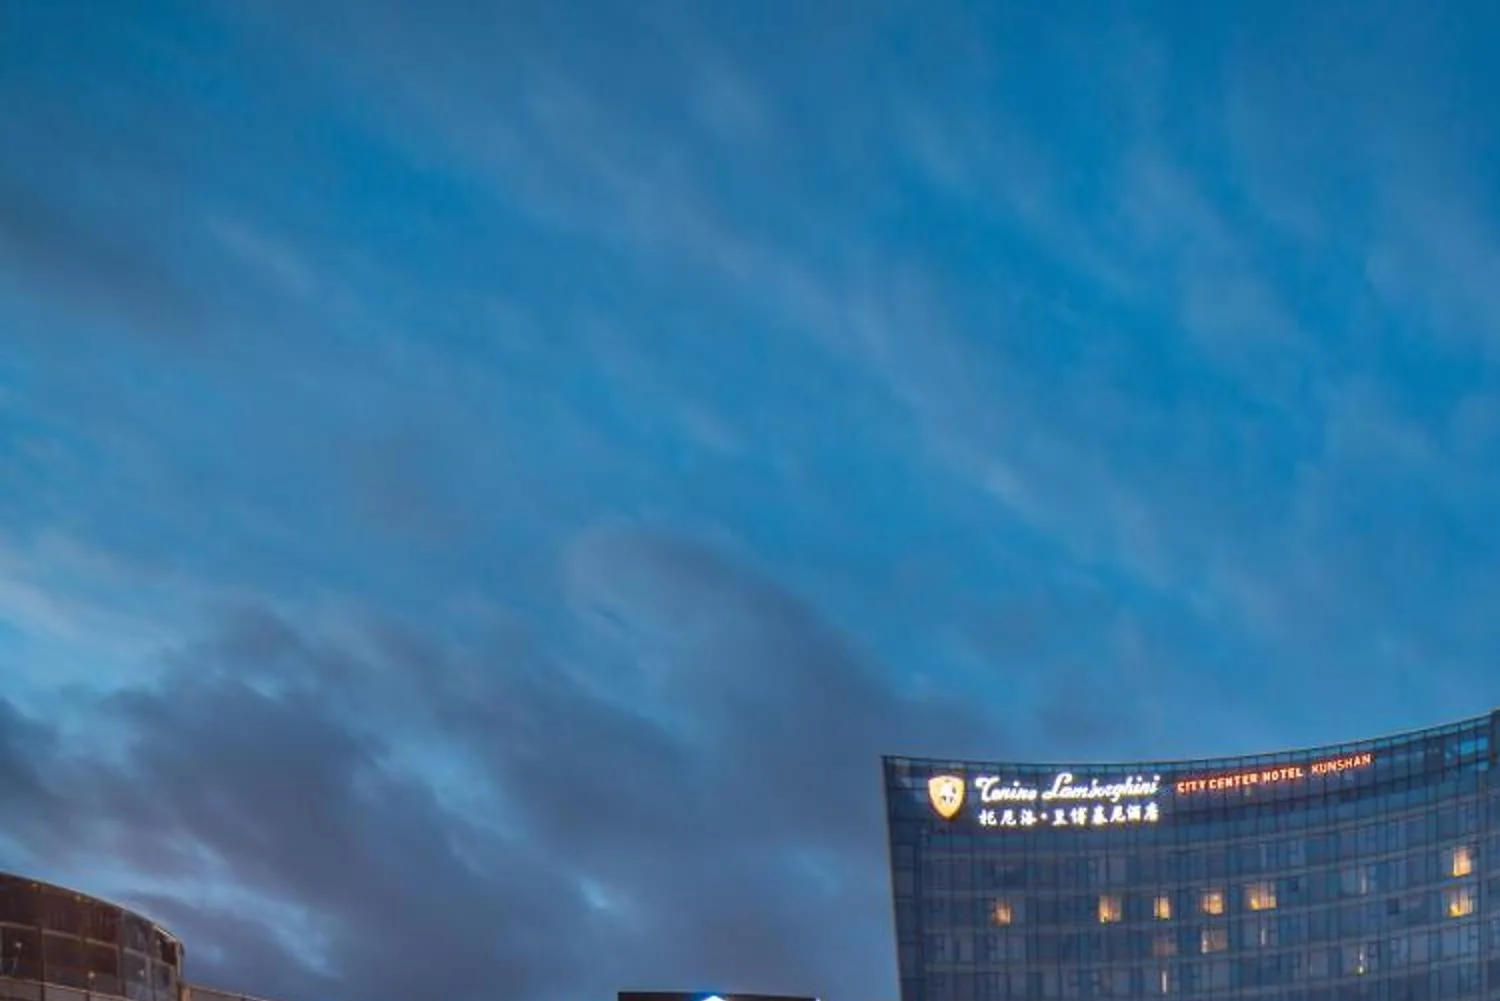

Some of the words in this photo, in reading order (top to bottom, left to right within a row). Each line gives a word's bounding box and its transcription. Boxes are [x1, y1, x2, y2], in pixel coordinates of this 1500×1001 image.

[975, 776, 1037, 803] Tonino
[1042, 772, 1161, 803] Lamborghini
[1177, 779, 1206, 794] CITY
[1208, 772, 1259, 790] CENTER
[1262, 767, 1304, 783] HOTEL
[1311, 753, 1372, 775] KUNSHAN
